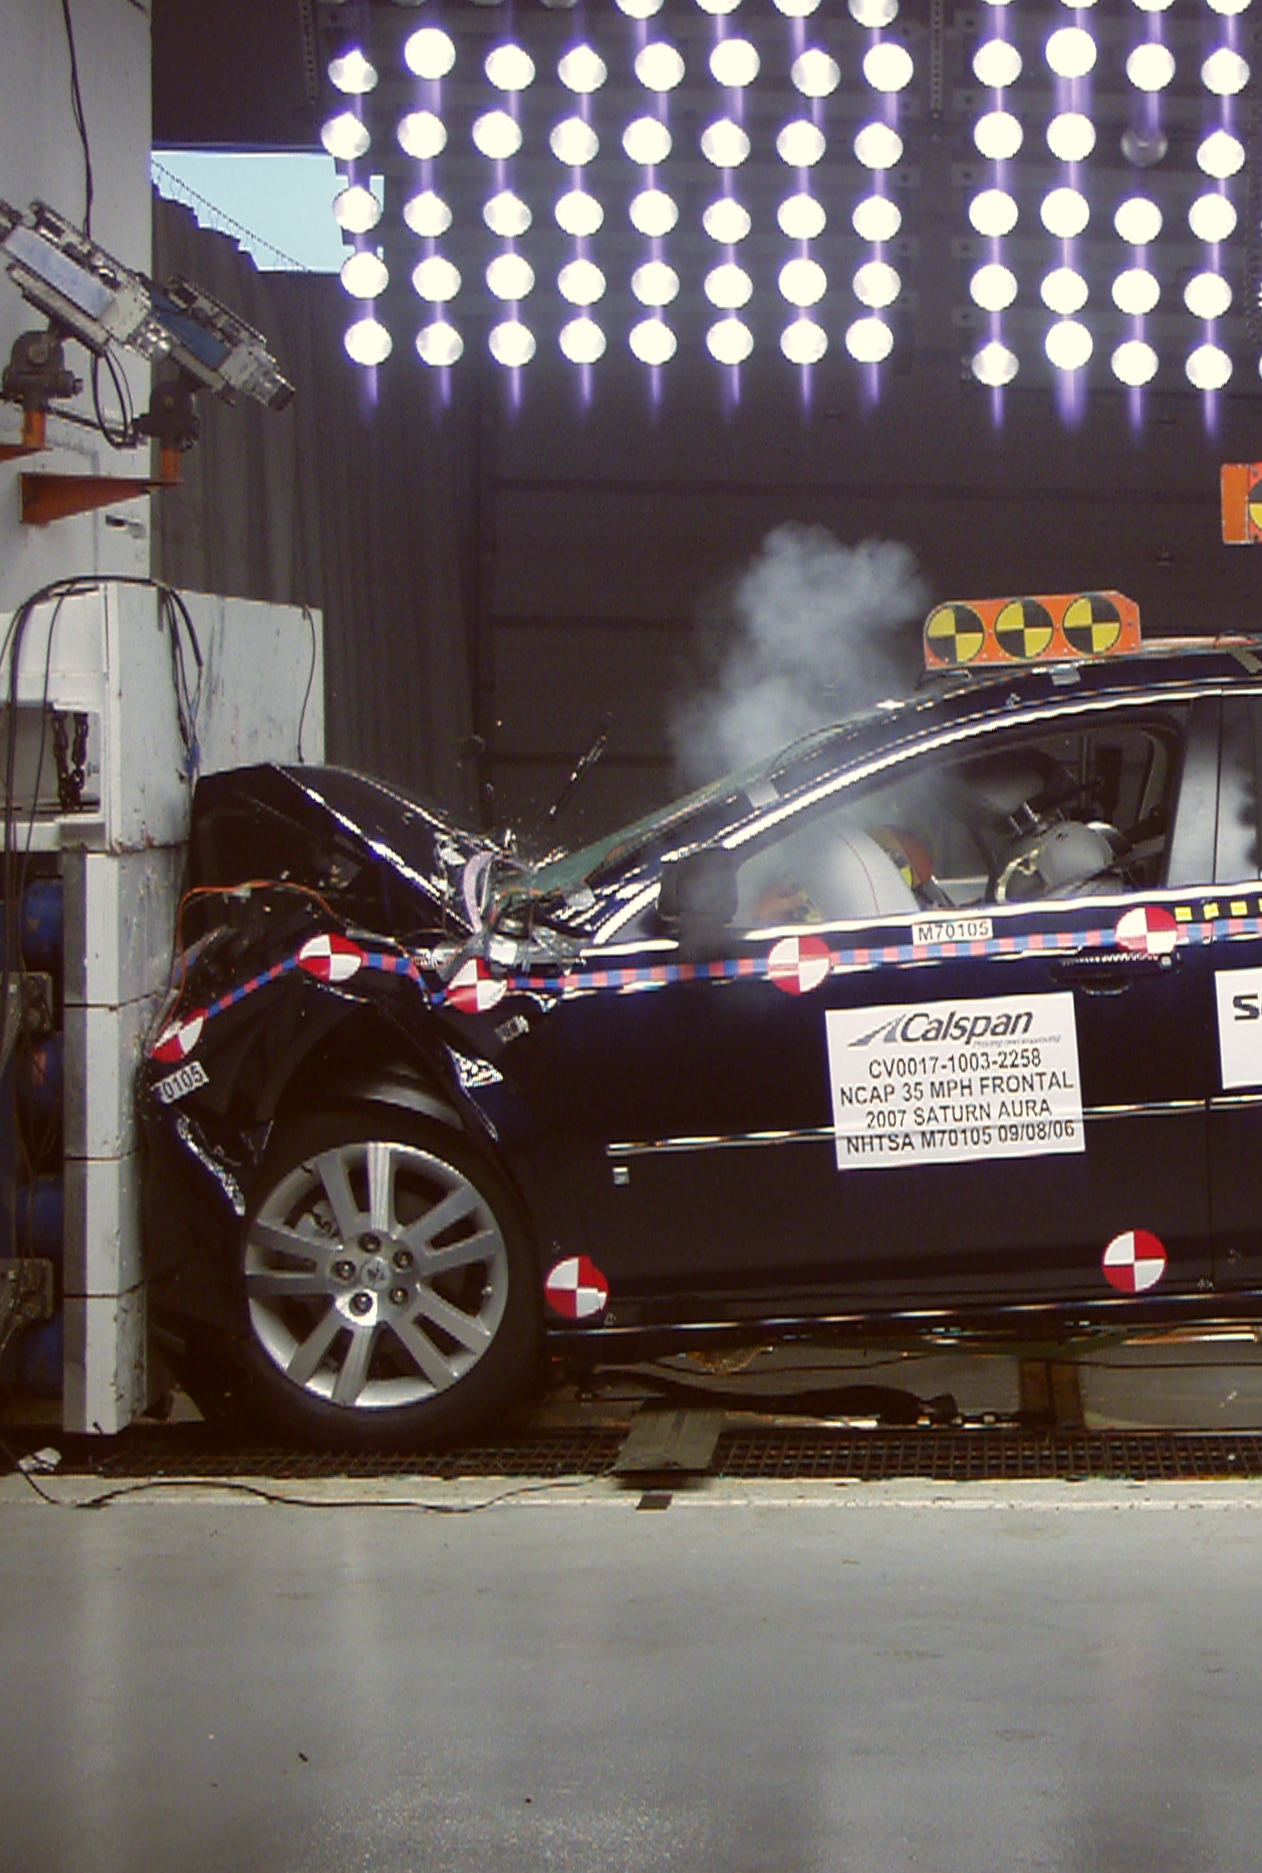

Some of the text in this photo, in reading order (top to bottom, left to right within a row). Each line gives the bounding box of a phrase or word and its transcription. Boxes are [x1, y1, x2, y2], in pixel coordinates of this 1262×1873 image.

[917, 919, 989, 942] M70105
[900, 1011, 1033, 1045] Calspan
[868, 1048, 1042, 1079] CV0017-1003-2258
[158, 1064, 204, 1099] 0105
[840, 1072, 1074, 1106] NCAP 35 MPH FRONTAL
[866, 1099, 1051, 1129] 2007 SATURN AURA
[847, 1119, 1075, 1154] NHTSA M70105 09/08/06
